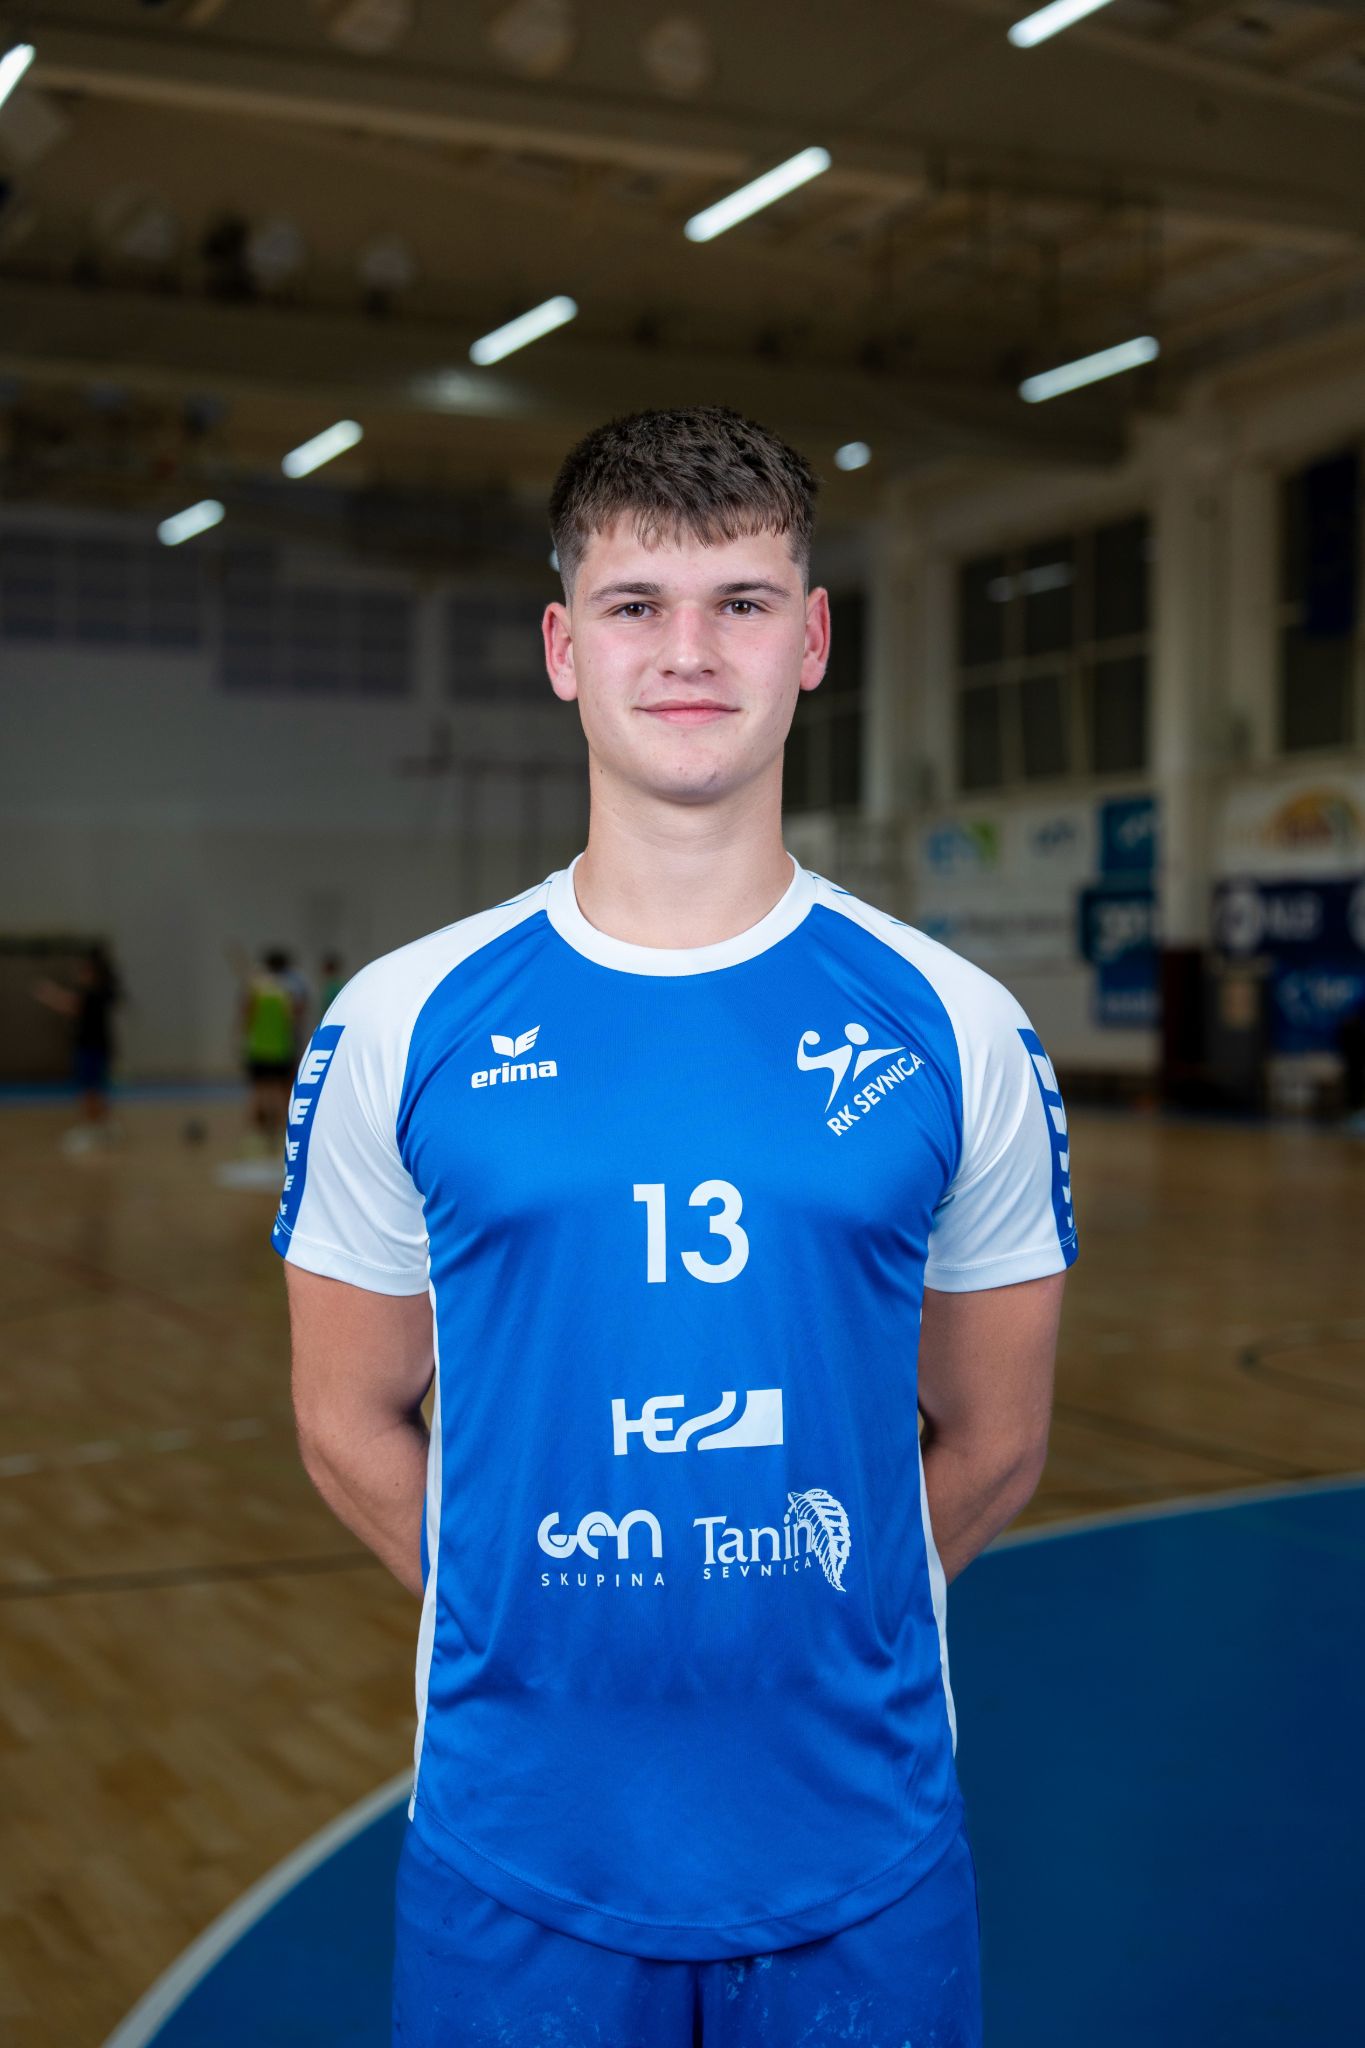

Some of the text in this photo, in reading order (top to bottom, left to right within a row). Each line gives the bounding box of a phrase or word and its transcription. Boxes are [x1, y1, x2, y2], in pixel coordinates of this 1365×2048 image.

[471, 1060, 558, 1089] erima
[826, 1052, 926, 1138] RK SEVNICA
[633, 1179, 750, 1284] 13
[693, 1513, 816, 1564] Tanin
[540, 1572, 666, 1588] SKUPINA
[702, 1557, 812, 1581] SEVNICA
